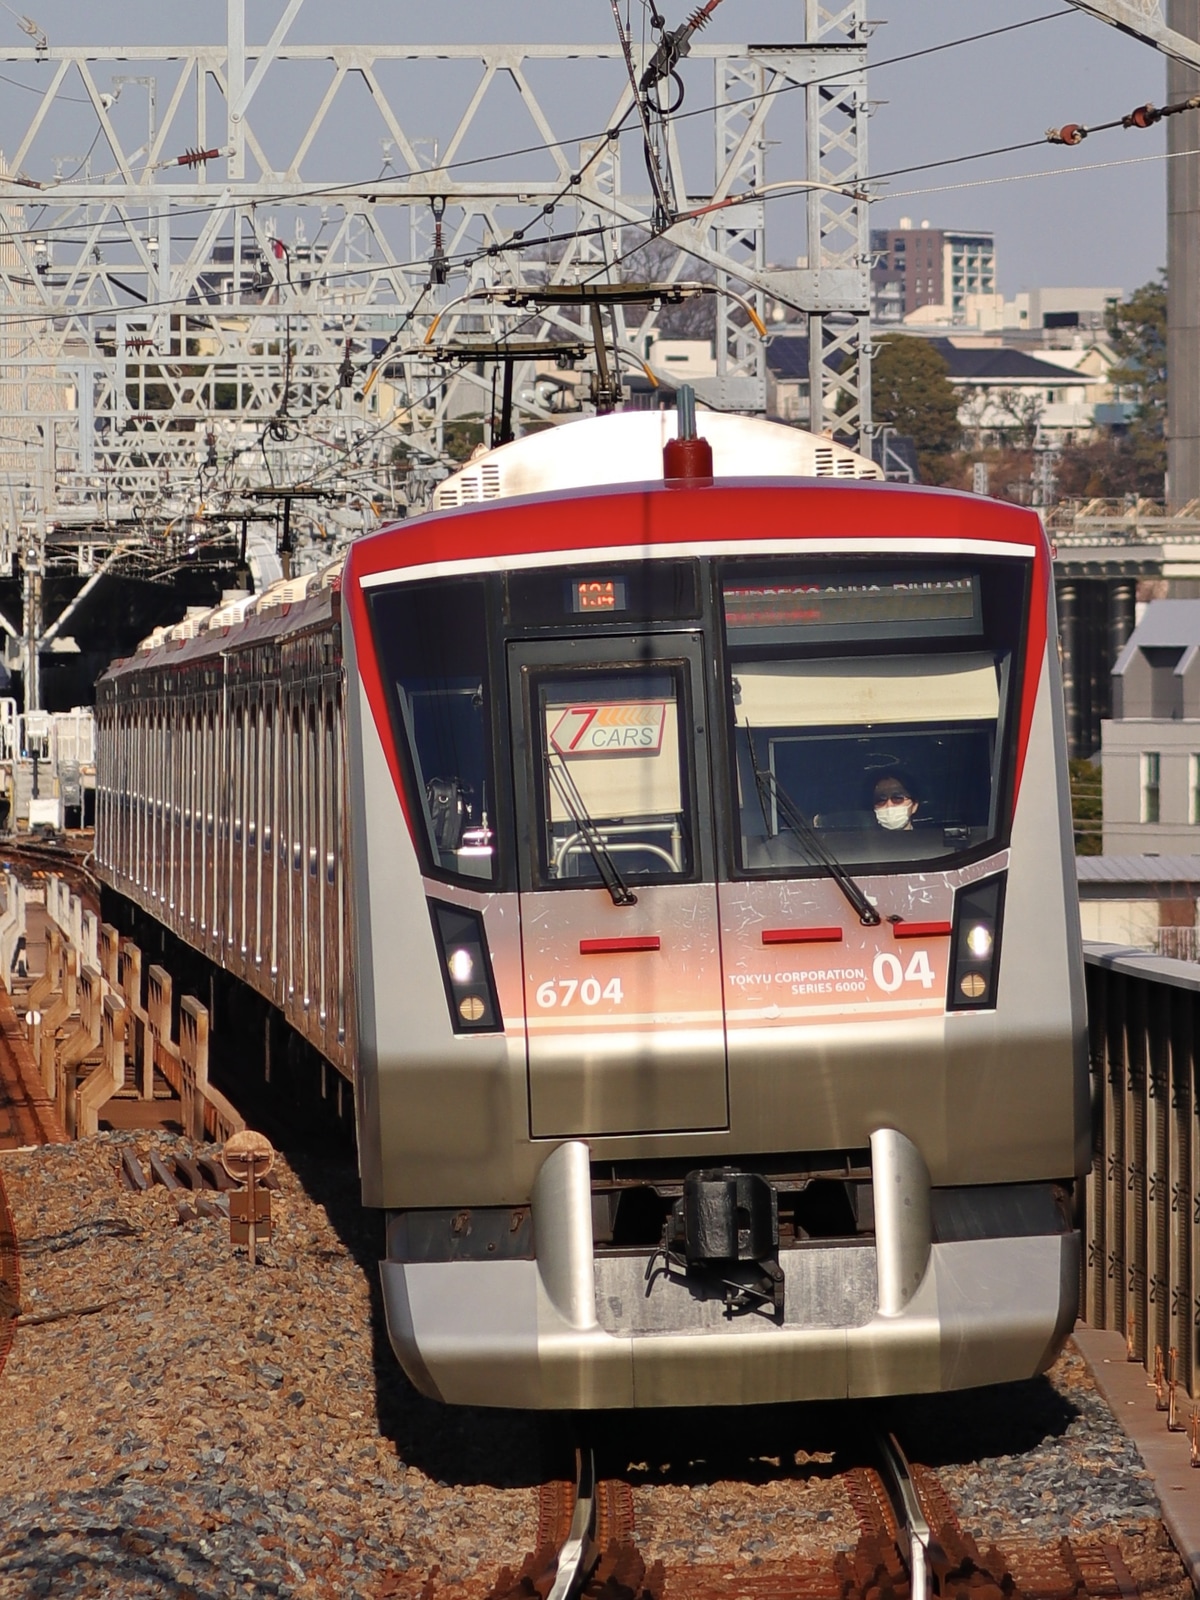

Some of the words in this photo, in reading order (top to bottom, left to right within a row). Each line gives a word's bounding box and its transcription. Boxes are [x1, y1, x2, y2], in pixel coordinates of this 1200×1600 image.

[569, 709, 598, 750] 7
[592, 727, 654, 747] CARS
[729, 974, 771, 986] TOKYU
[774, 969, 865, 983] CORPORATION
[872, 951, 936, 992] 04
[536, 977, 624, 1008] 6704
[791, 982, 833, 995] SERIES
[835, 981, 866, 993] 6000
